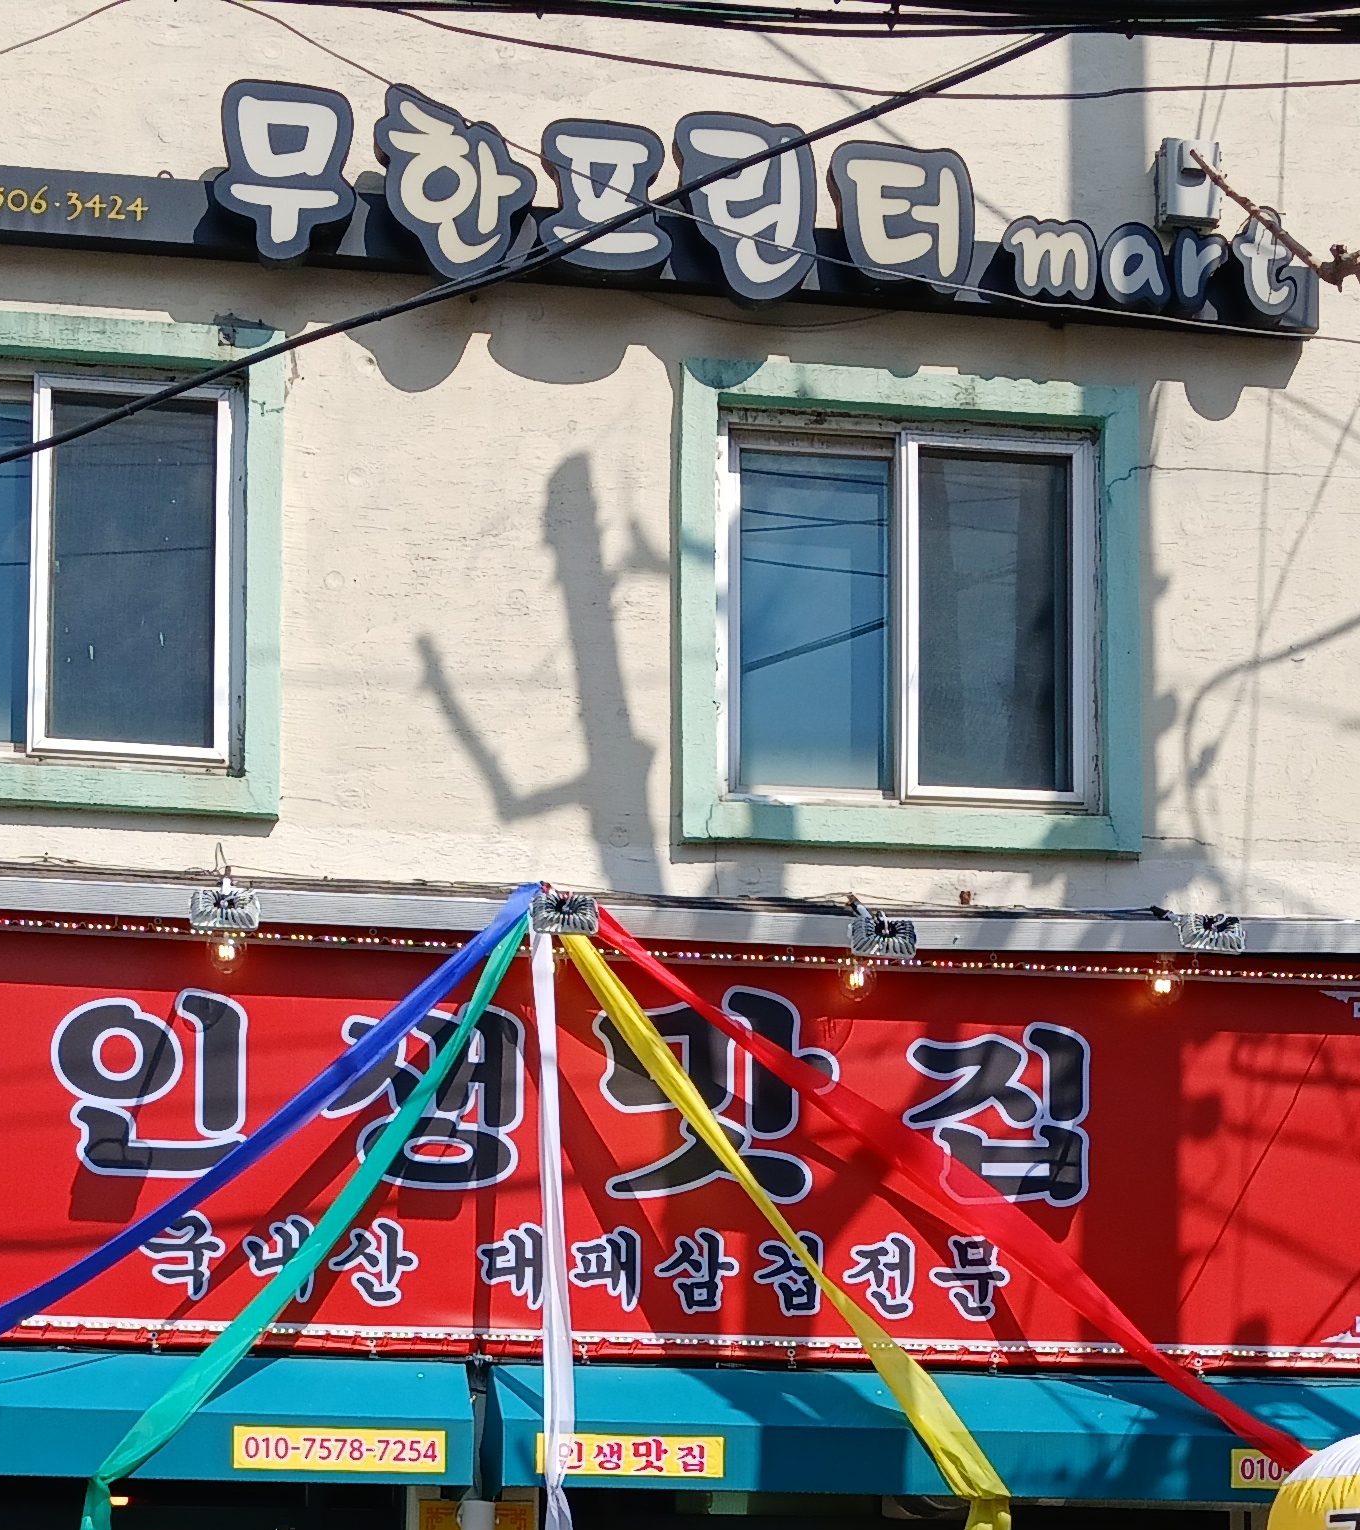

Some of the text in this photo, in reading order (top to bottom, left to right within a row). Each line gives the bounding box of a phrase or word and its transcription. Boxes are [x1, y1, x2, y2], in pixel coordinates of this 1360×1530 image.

[226, 90, 1298, 314] 무한프린터 mart
[140, 1208, 418, 1307] 국내산
[243, 1434, 439, 1466] 010-7578-7254
